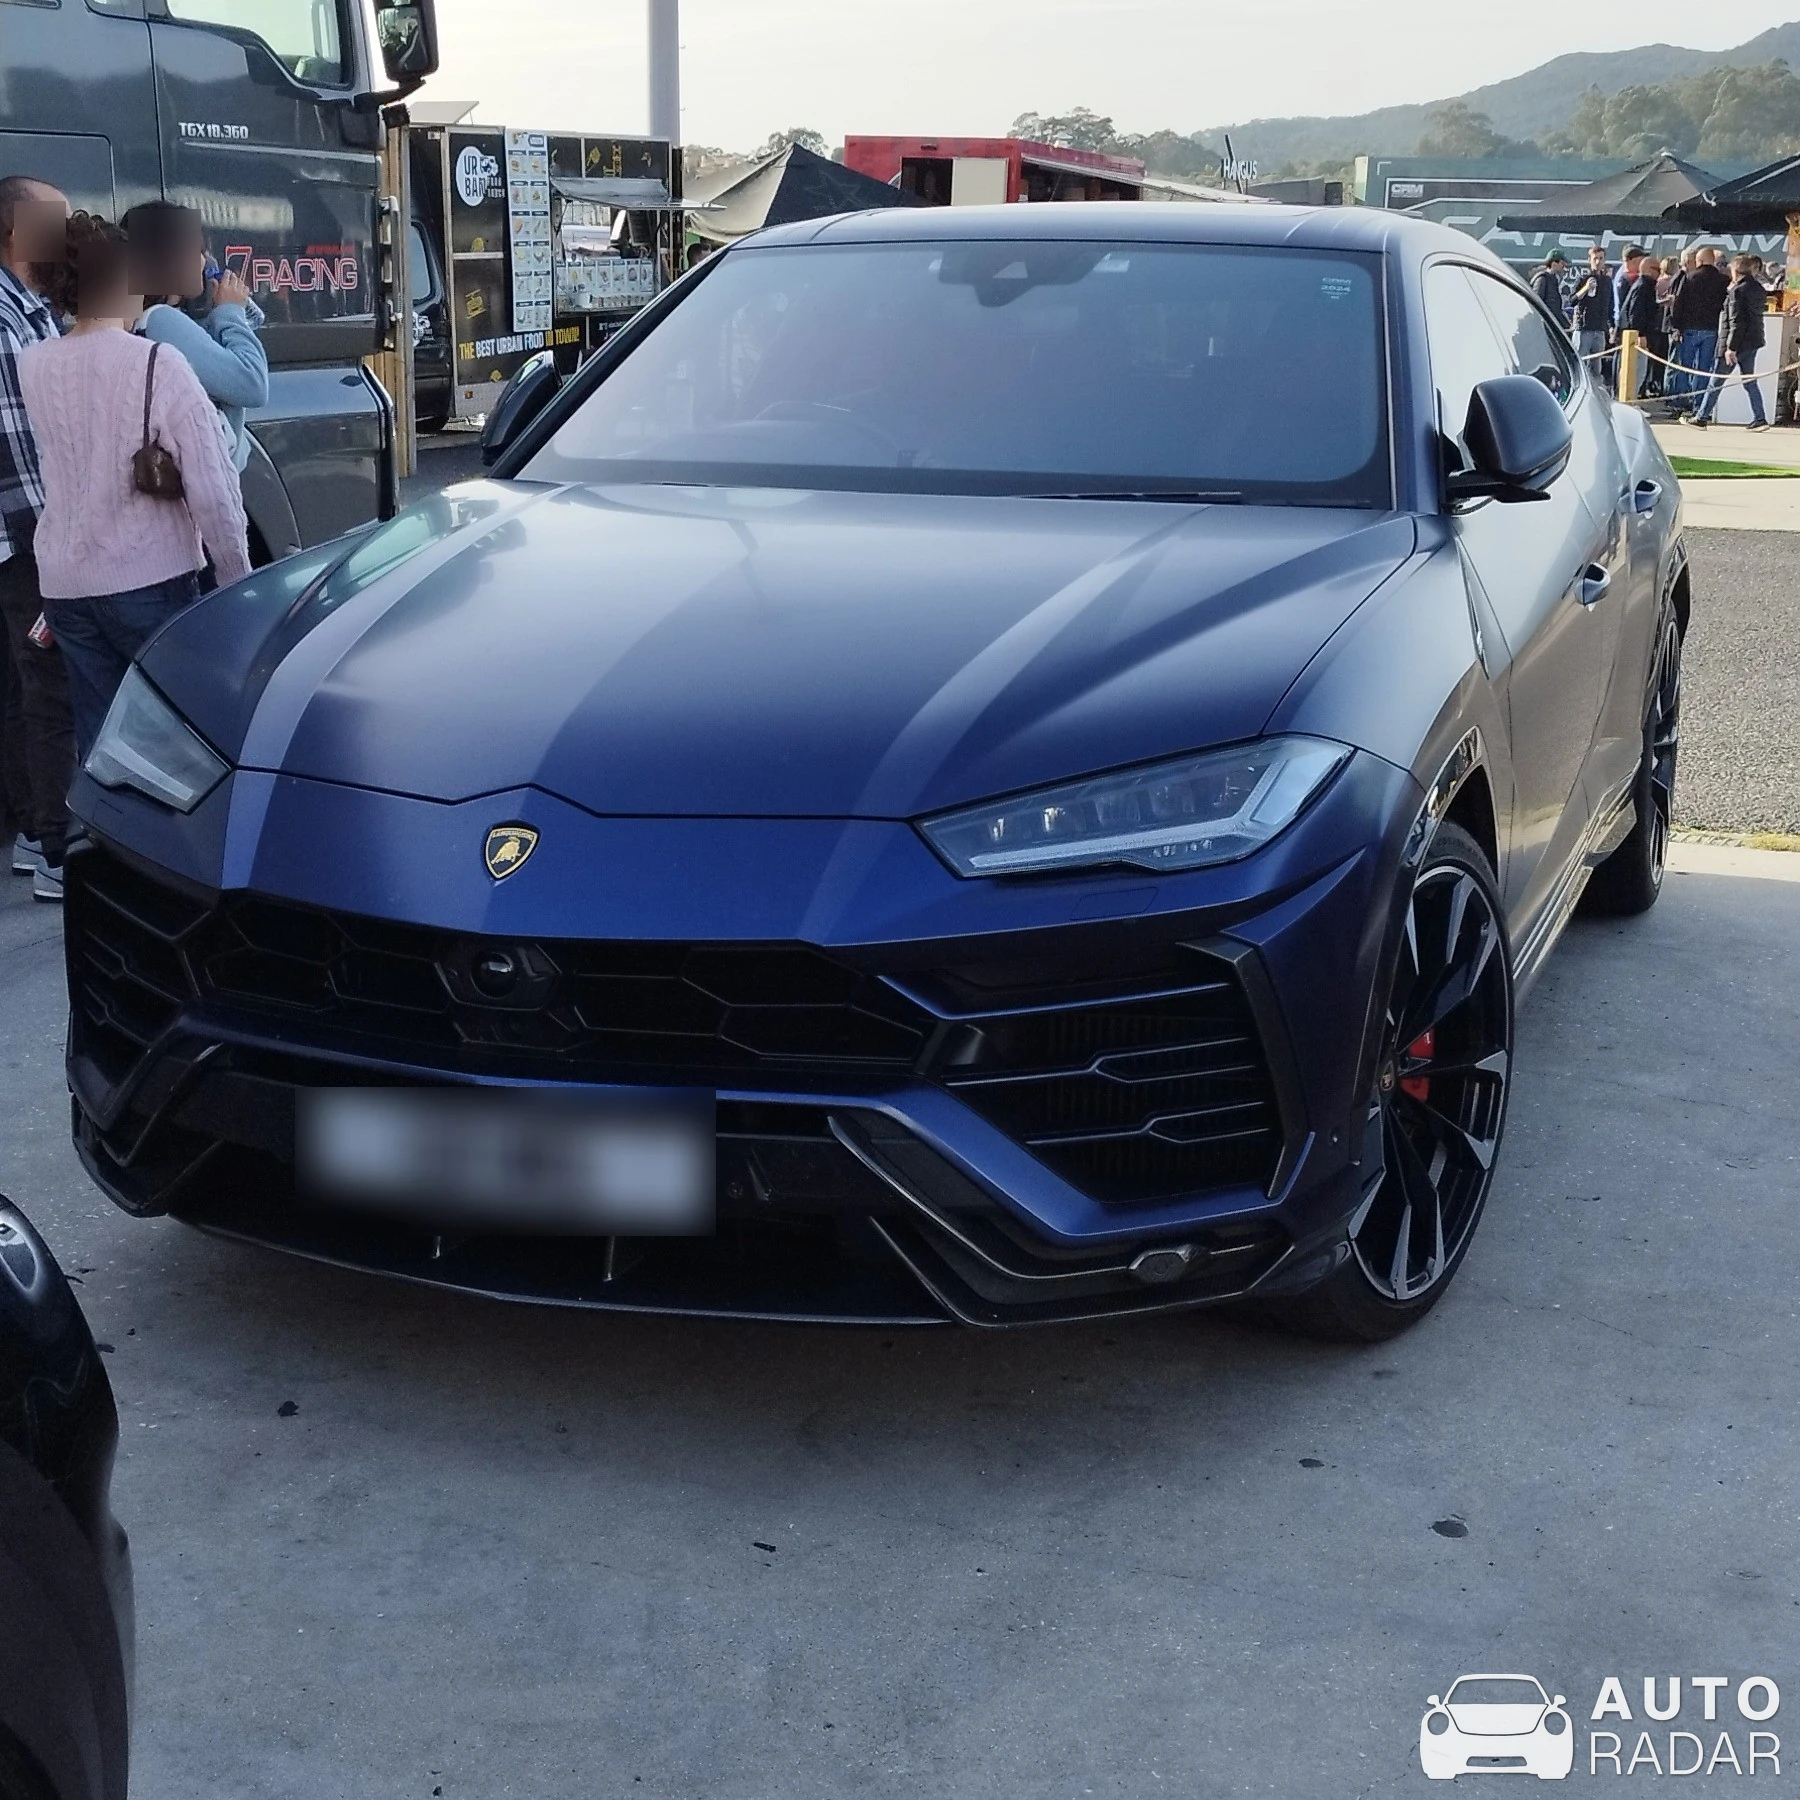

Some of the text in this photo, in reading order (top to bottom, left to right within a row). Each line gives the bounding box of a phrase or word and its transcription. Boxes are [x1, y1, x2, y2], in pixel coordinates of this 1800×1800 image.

[252, 257, 359, 293] RACING
[458, 341, 475, 360] THE
[475, 339, 495, 359] BEST
[496, 335, 523, 355] URBAN
[524, 332, 544, 351] FOOD
